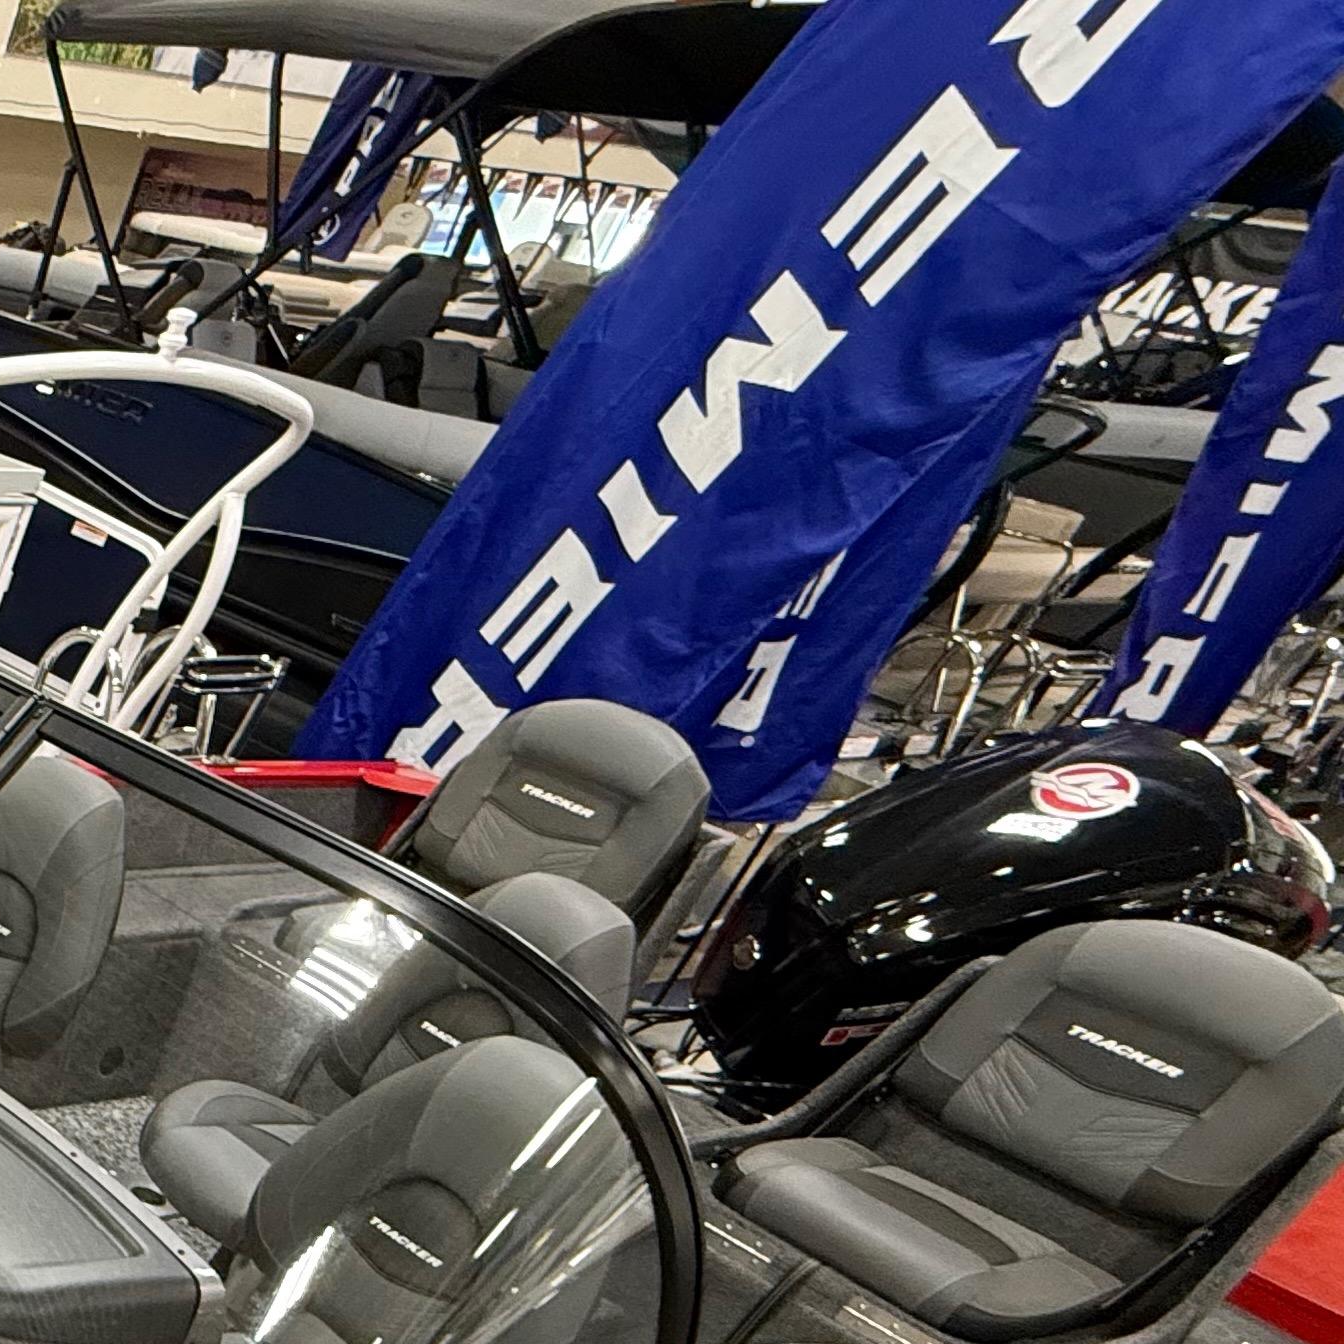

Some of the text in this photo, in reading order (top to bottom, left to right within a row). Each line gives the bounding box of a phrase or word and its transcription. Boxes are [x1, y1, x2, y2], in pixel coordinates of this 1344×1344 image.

[520, 783, 596, 819] TRACKER
[1067, 1024, 1185, 1080] TRACKER
[369, 1215, 443, 1269] TRACKER
